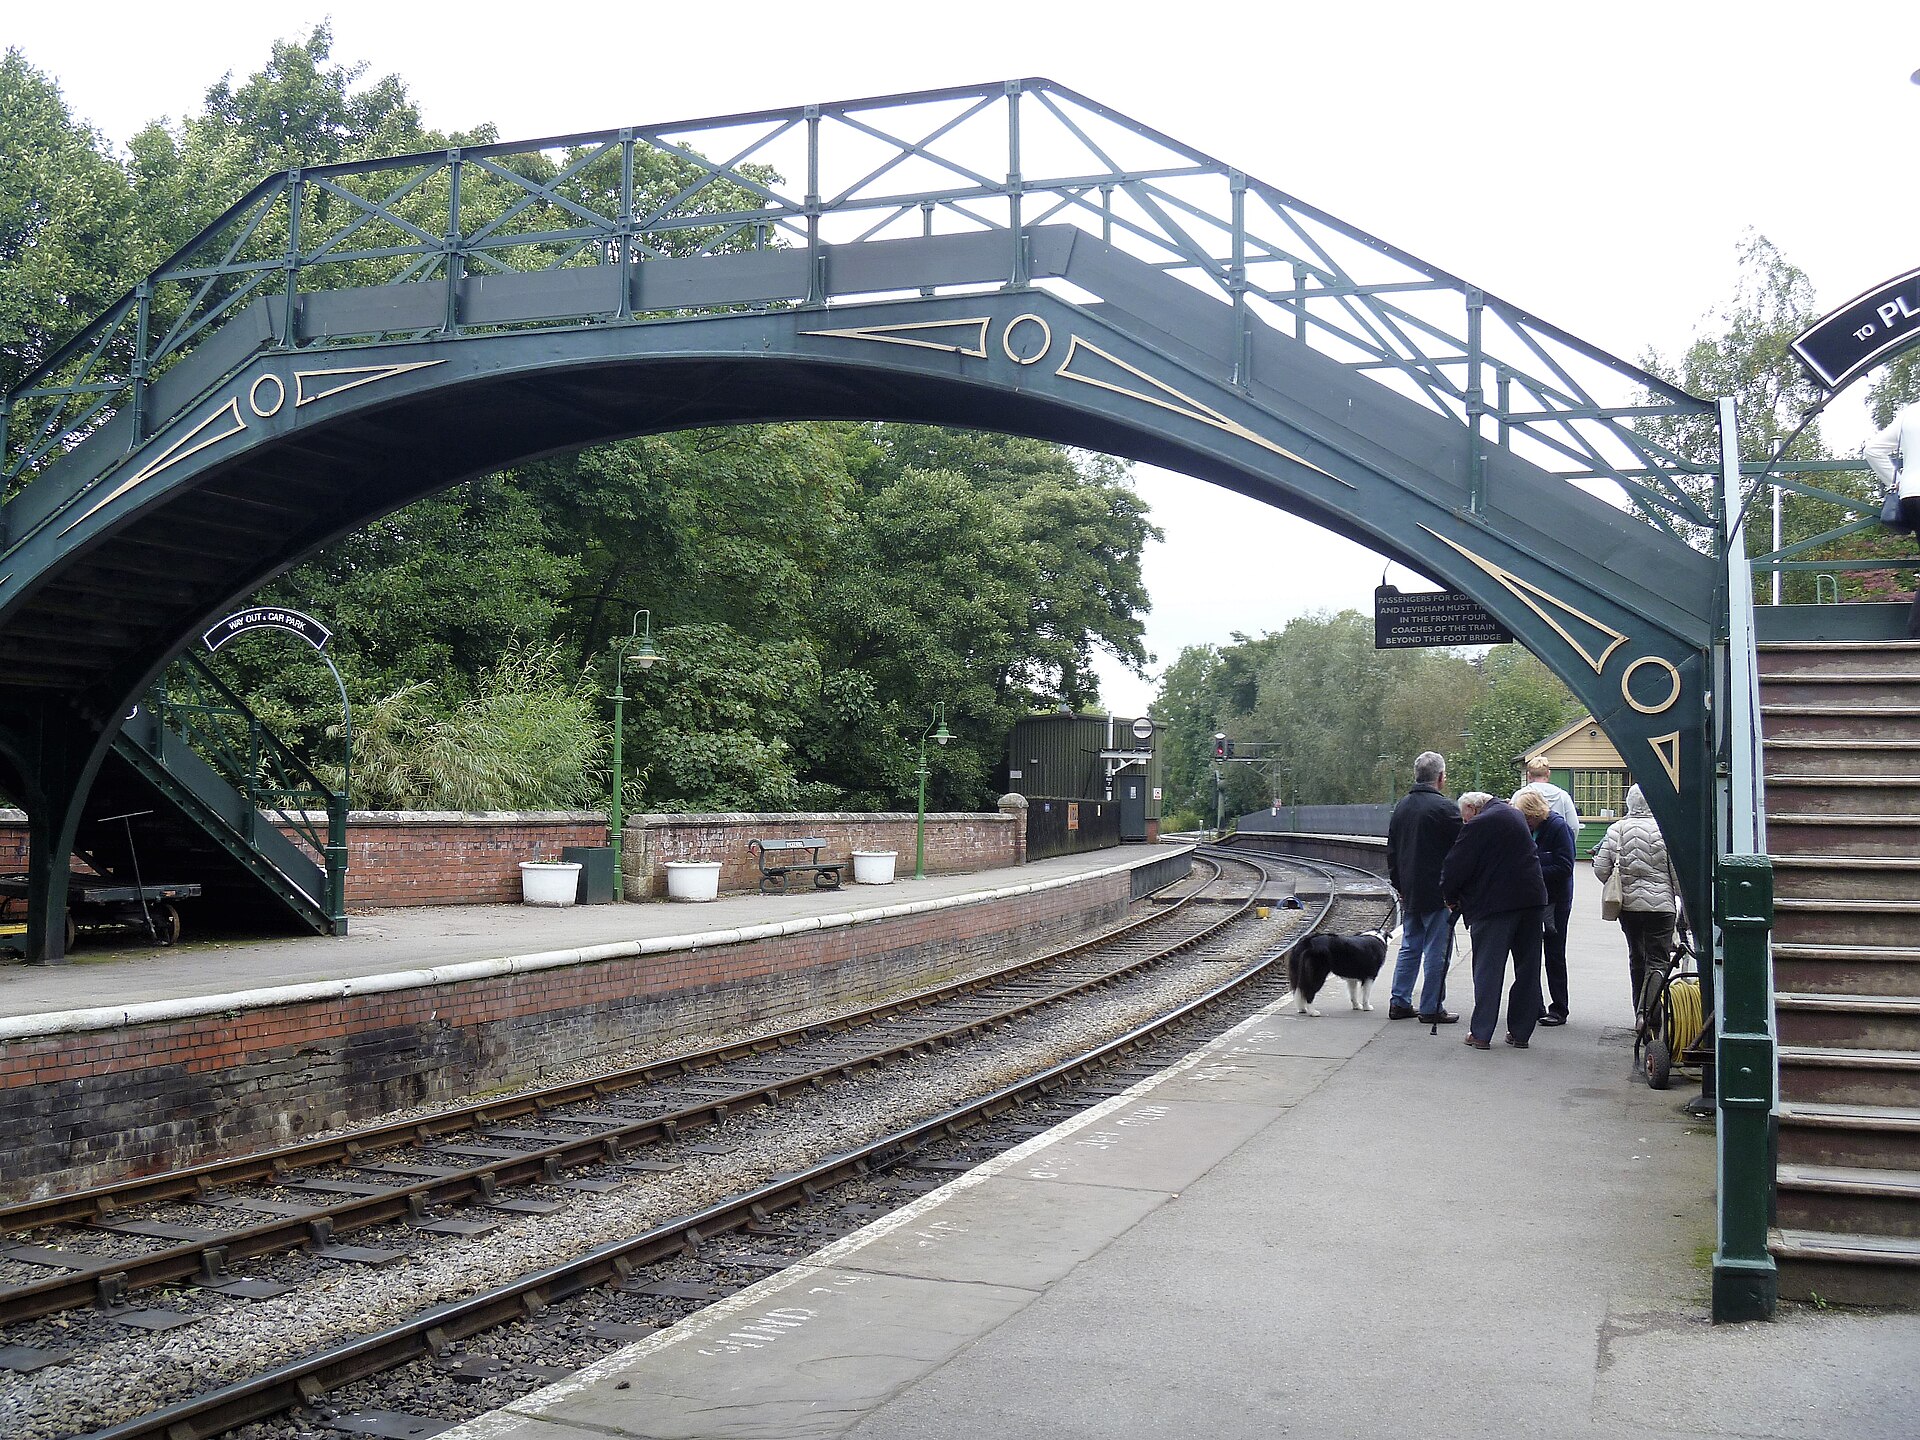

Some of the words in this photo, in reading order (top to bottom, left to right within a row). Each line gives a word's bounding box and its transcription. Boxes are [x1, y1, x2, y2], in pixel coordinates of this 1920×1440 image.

[1852, 322, 1876, 342] TO
[1378, 596, 1431, 604] PASSENGERS
[1402, 605, 1444, 613] LEVISHAM
[228, 617, 244, 630] WAY
[246, 613, 261, 622] OUT
[268, 612, 284, 622] CAR
[285, 616, 306, 631] PARK
[1431, 614, 1460, 622] FRONT
[1392, 626, 1432, 634] COACHES
[1450, 624, 1466, 632] THE
